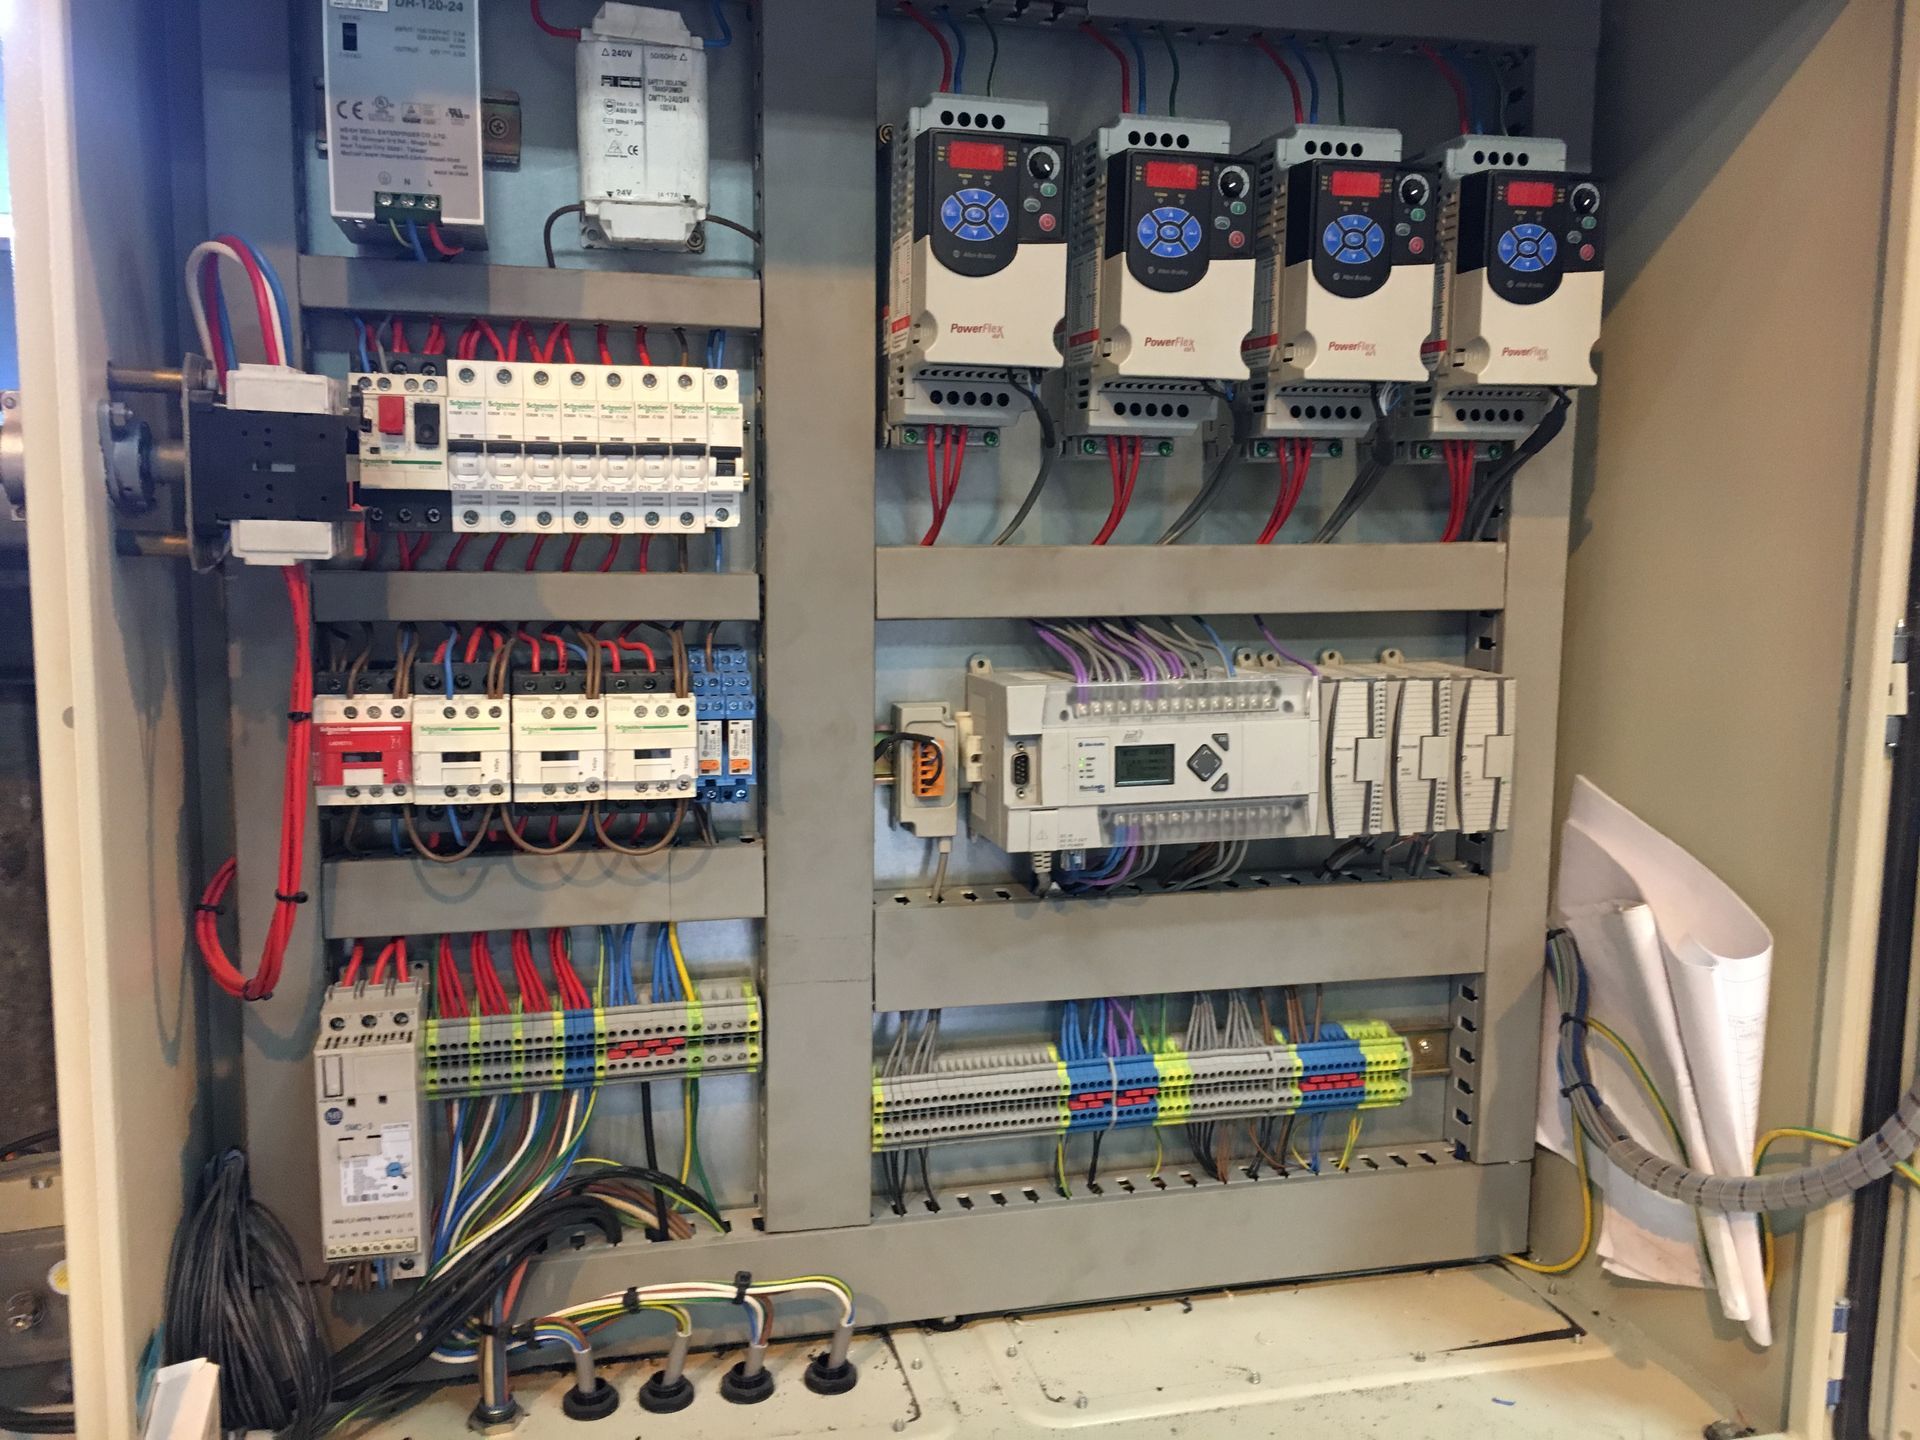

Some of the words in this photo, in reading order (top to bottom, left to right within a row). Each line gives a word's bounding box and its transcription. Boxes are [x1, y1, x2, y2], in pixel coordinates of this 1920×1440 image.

[611, 49, 633, 57] 240V
[404, 178, 411, 186] N
[950, 322, 1004, 338] PowerFlex
[1144, 336, 1196, 351] PowerFlex
[1328, 341, 1377, 356] PowerFlex
